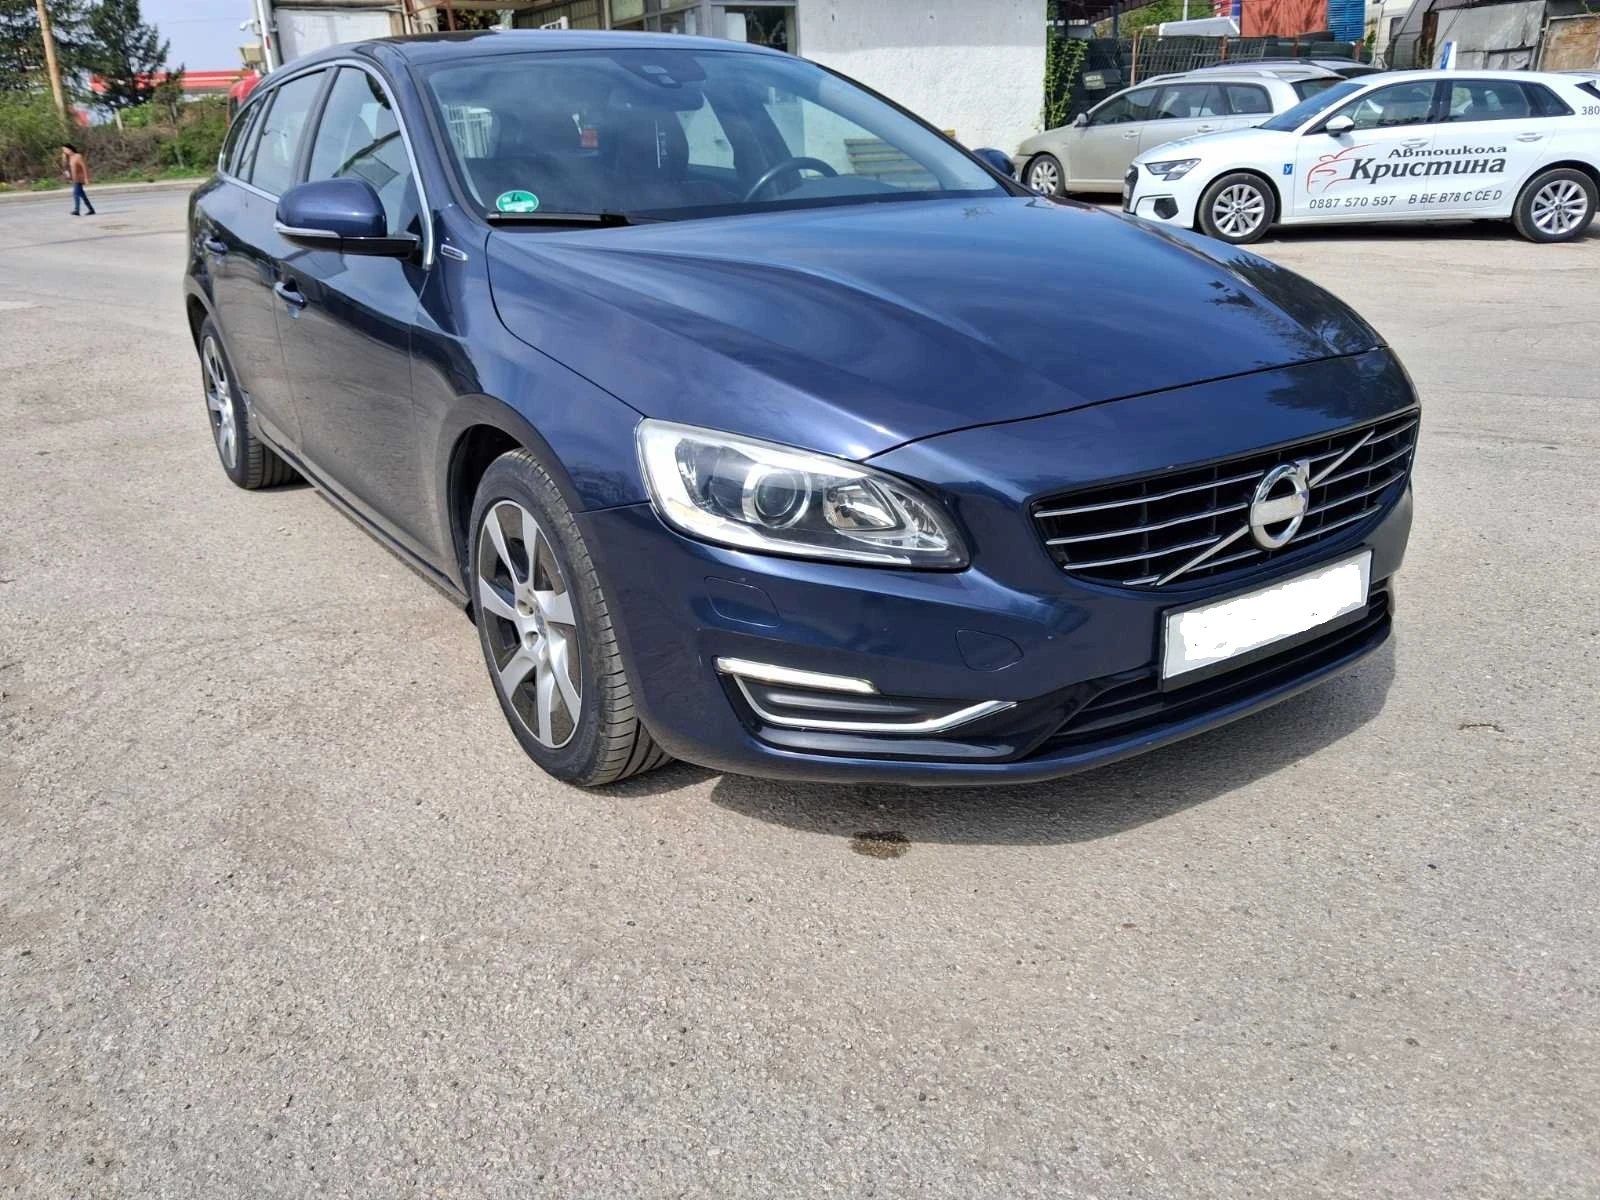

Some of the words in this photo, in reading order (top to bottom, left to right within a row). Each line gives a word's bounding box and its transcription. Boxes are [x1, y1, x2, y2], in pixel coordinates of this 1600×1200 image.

[1349, 158, 1506, 184] Кристина
[1309, 198, 1340, 208] 0887
[1344, 197, 1368, 207] 570
[1372, 195, 1396, 206] 597
[1463, 191, 1472, 202] C
[1474, 190, 1492, 201] CE
